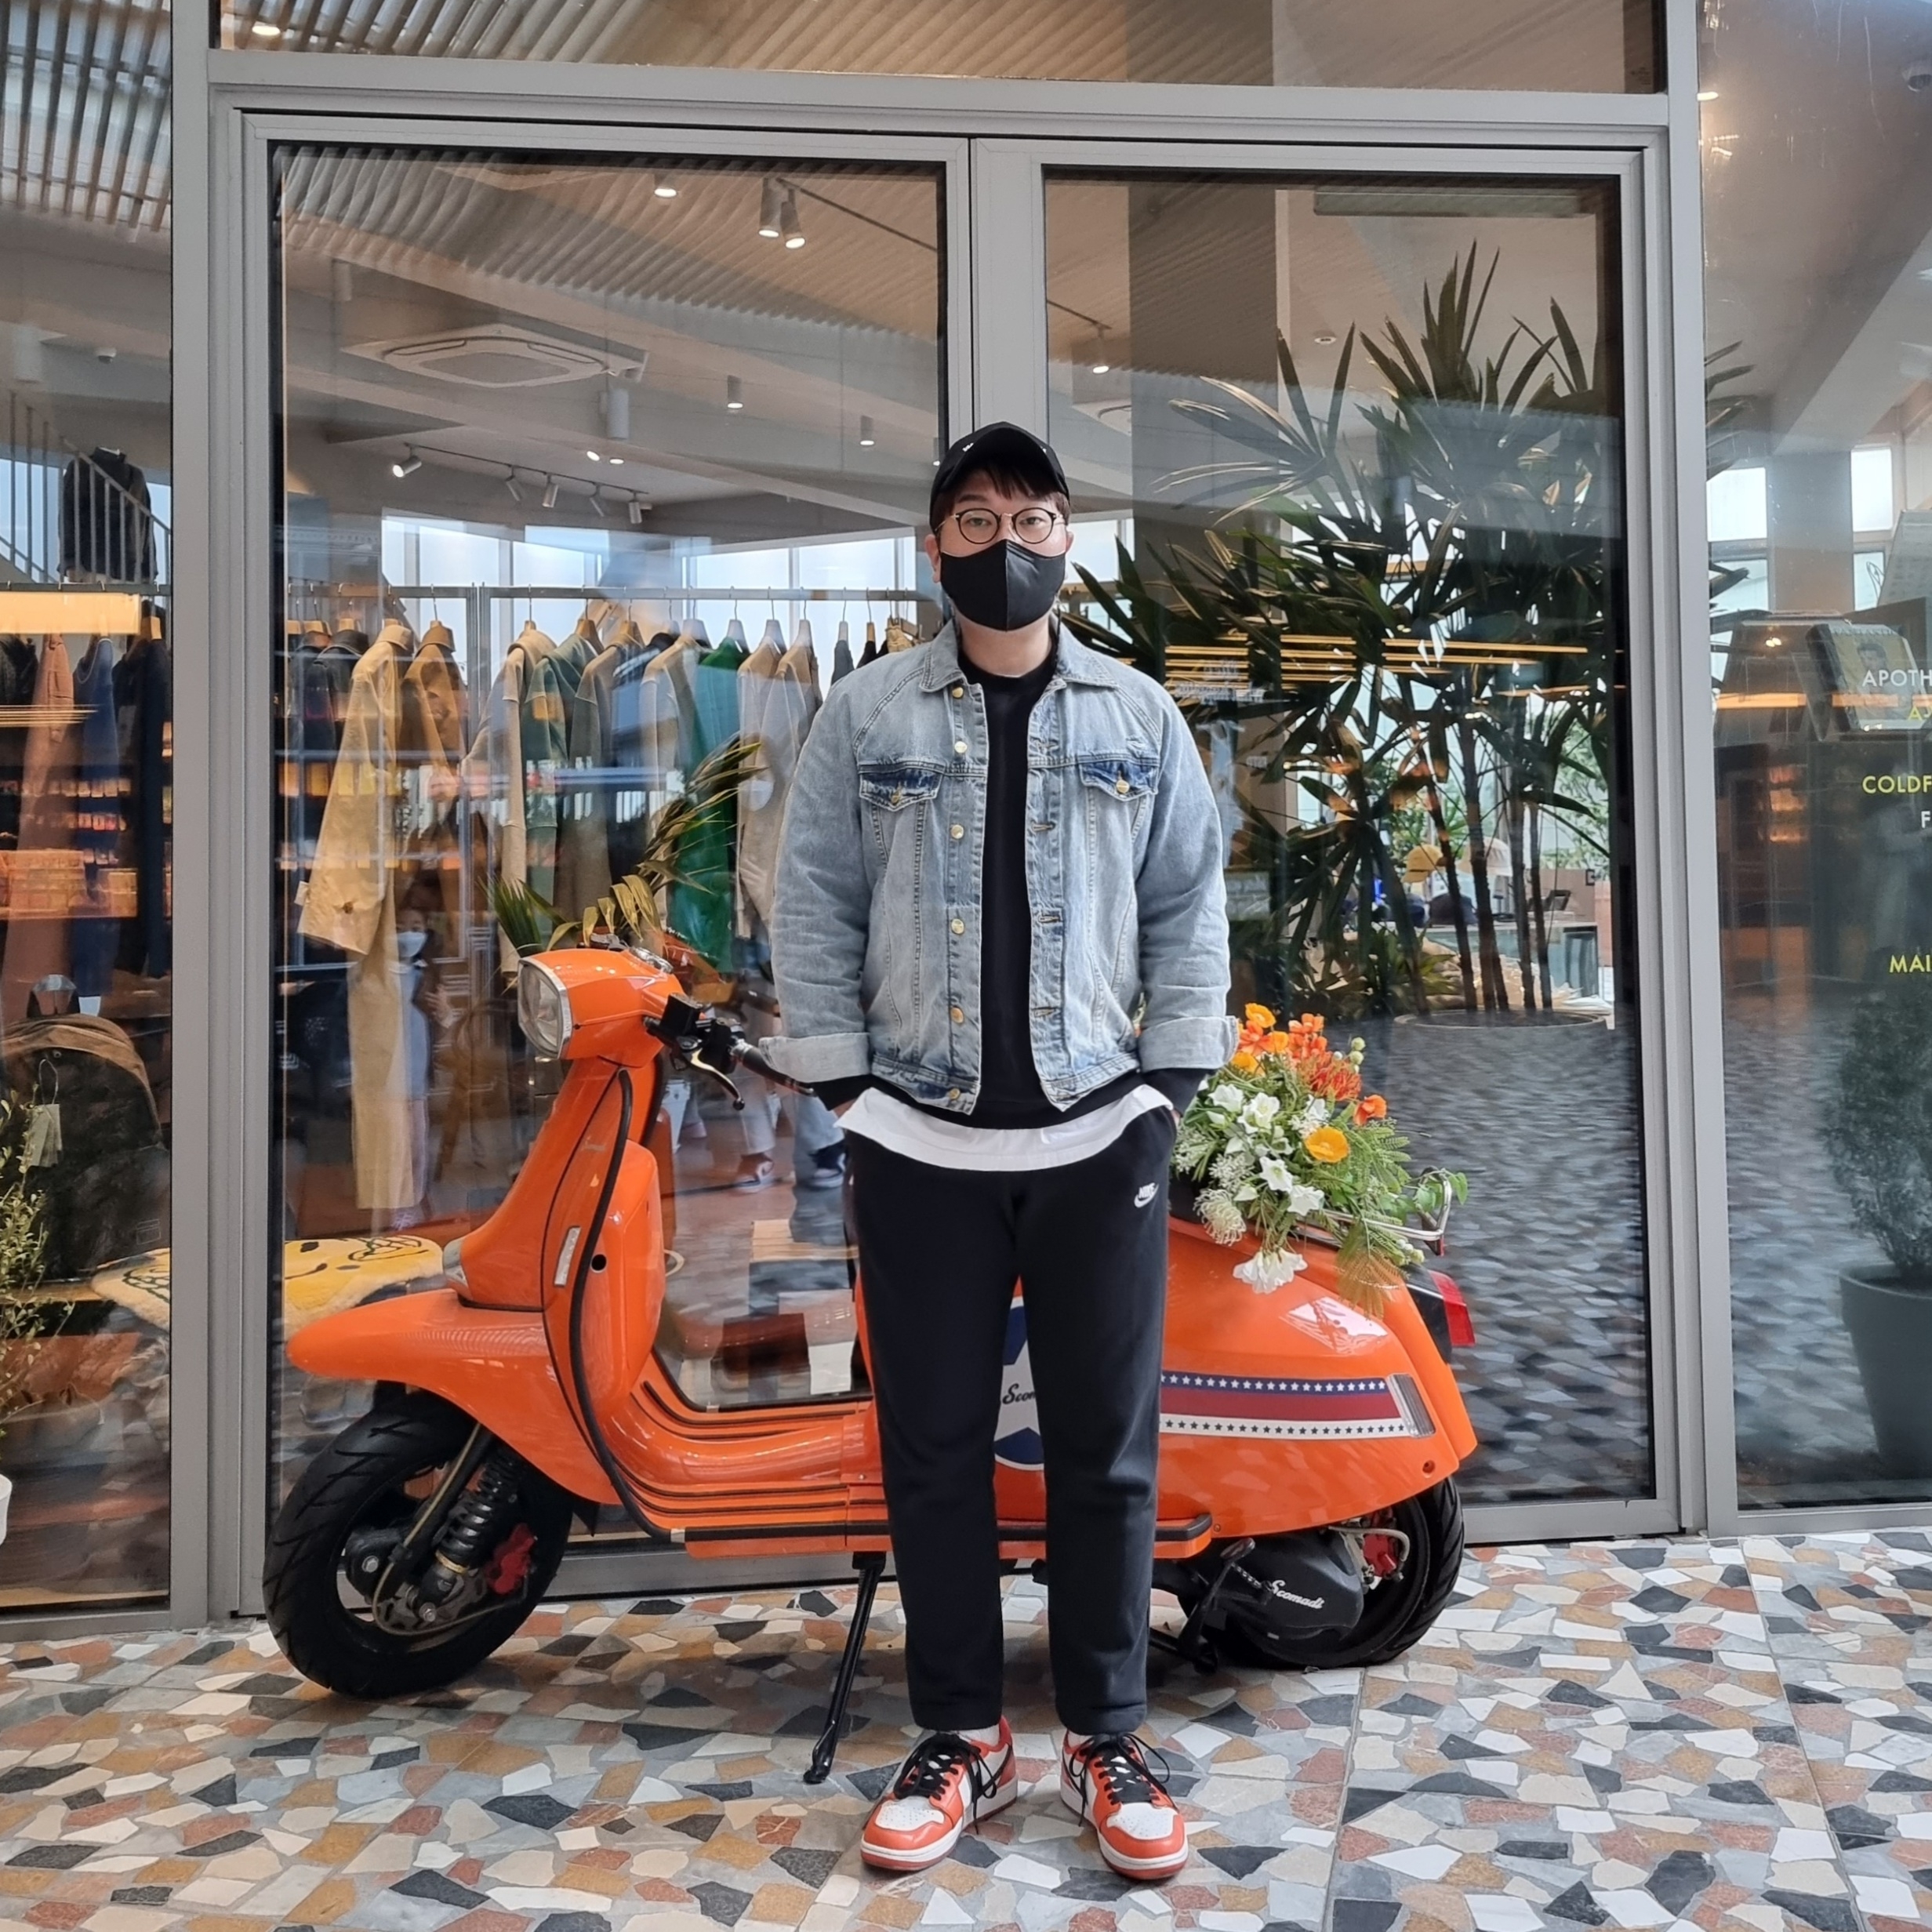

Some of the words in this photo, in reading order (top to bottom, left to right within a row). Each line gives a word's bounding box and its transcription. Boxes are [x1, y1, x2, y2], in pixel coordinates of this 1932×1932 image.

[1862, 669, 1932, 687] APOTH
[1862, 775, 1932, 794] COLDF
[1921, 811, 1930, 829] F
[1890, 954, 1931, 972] MAI
